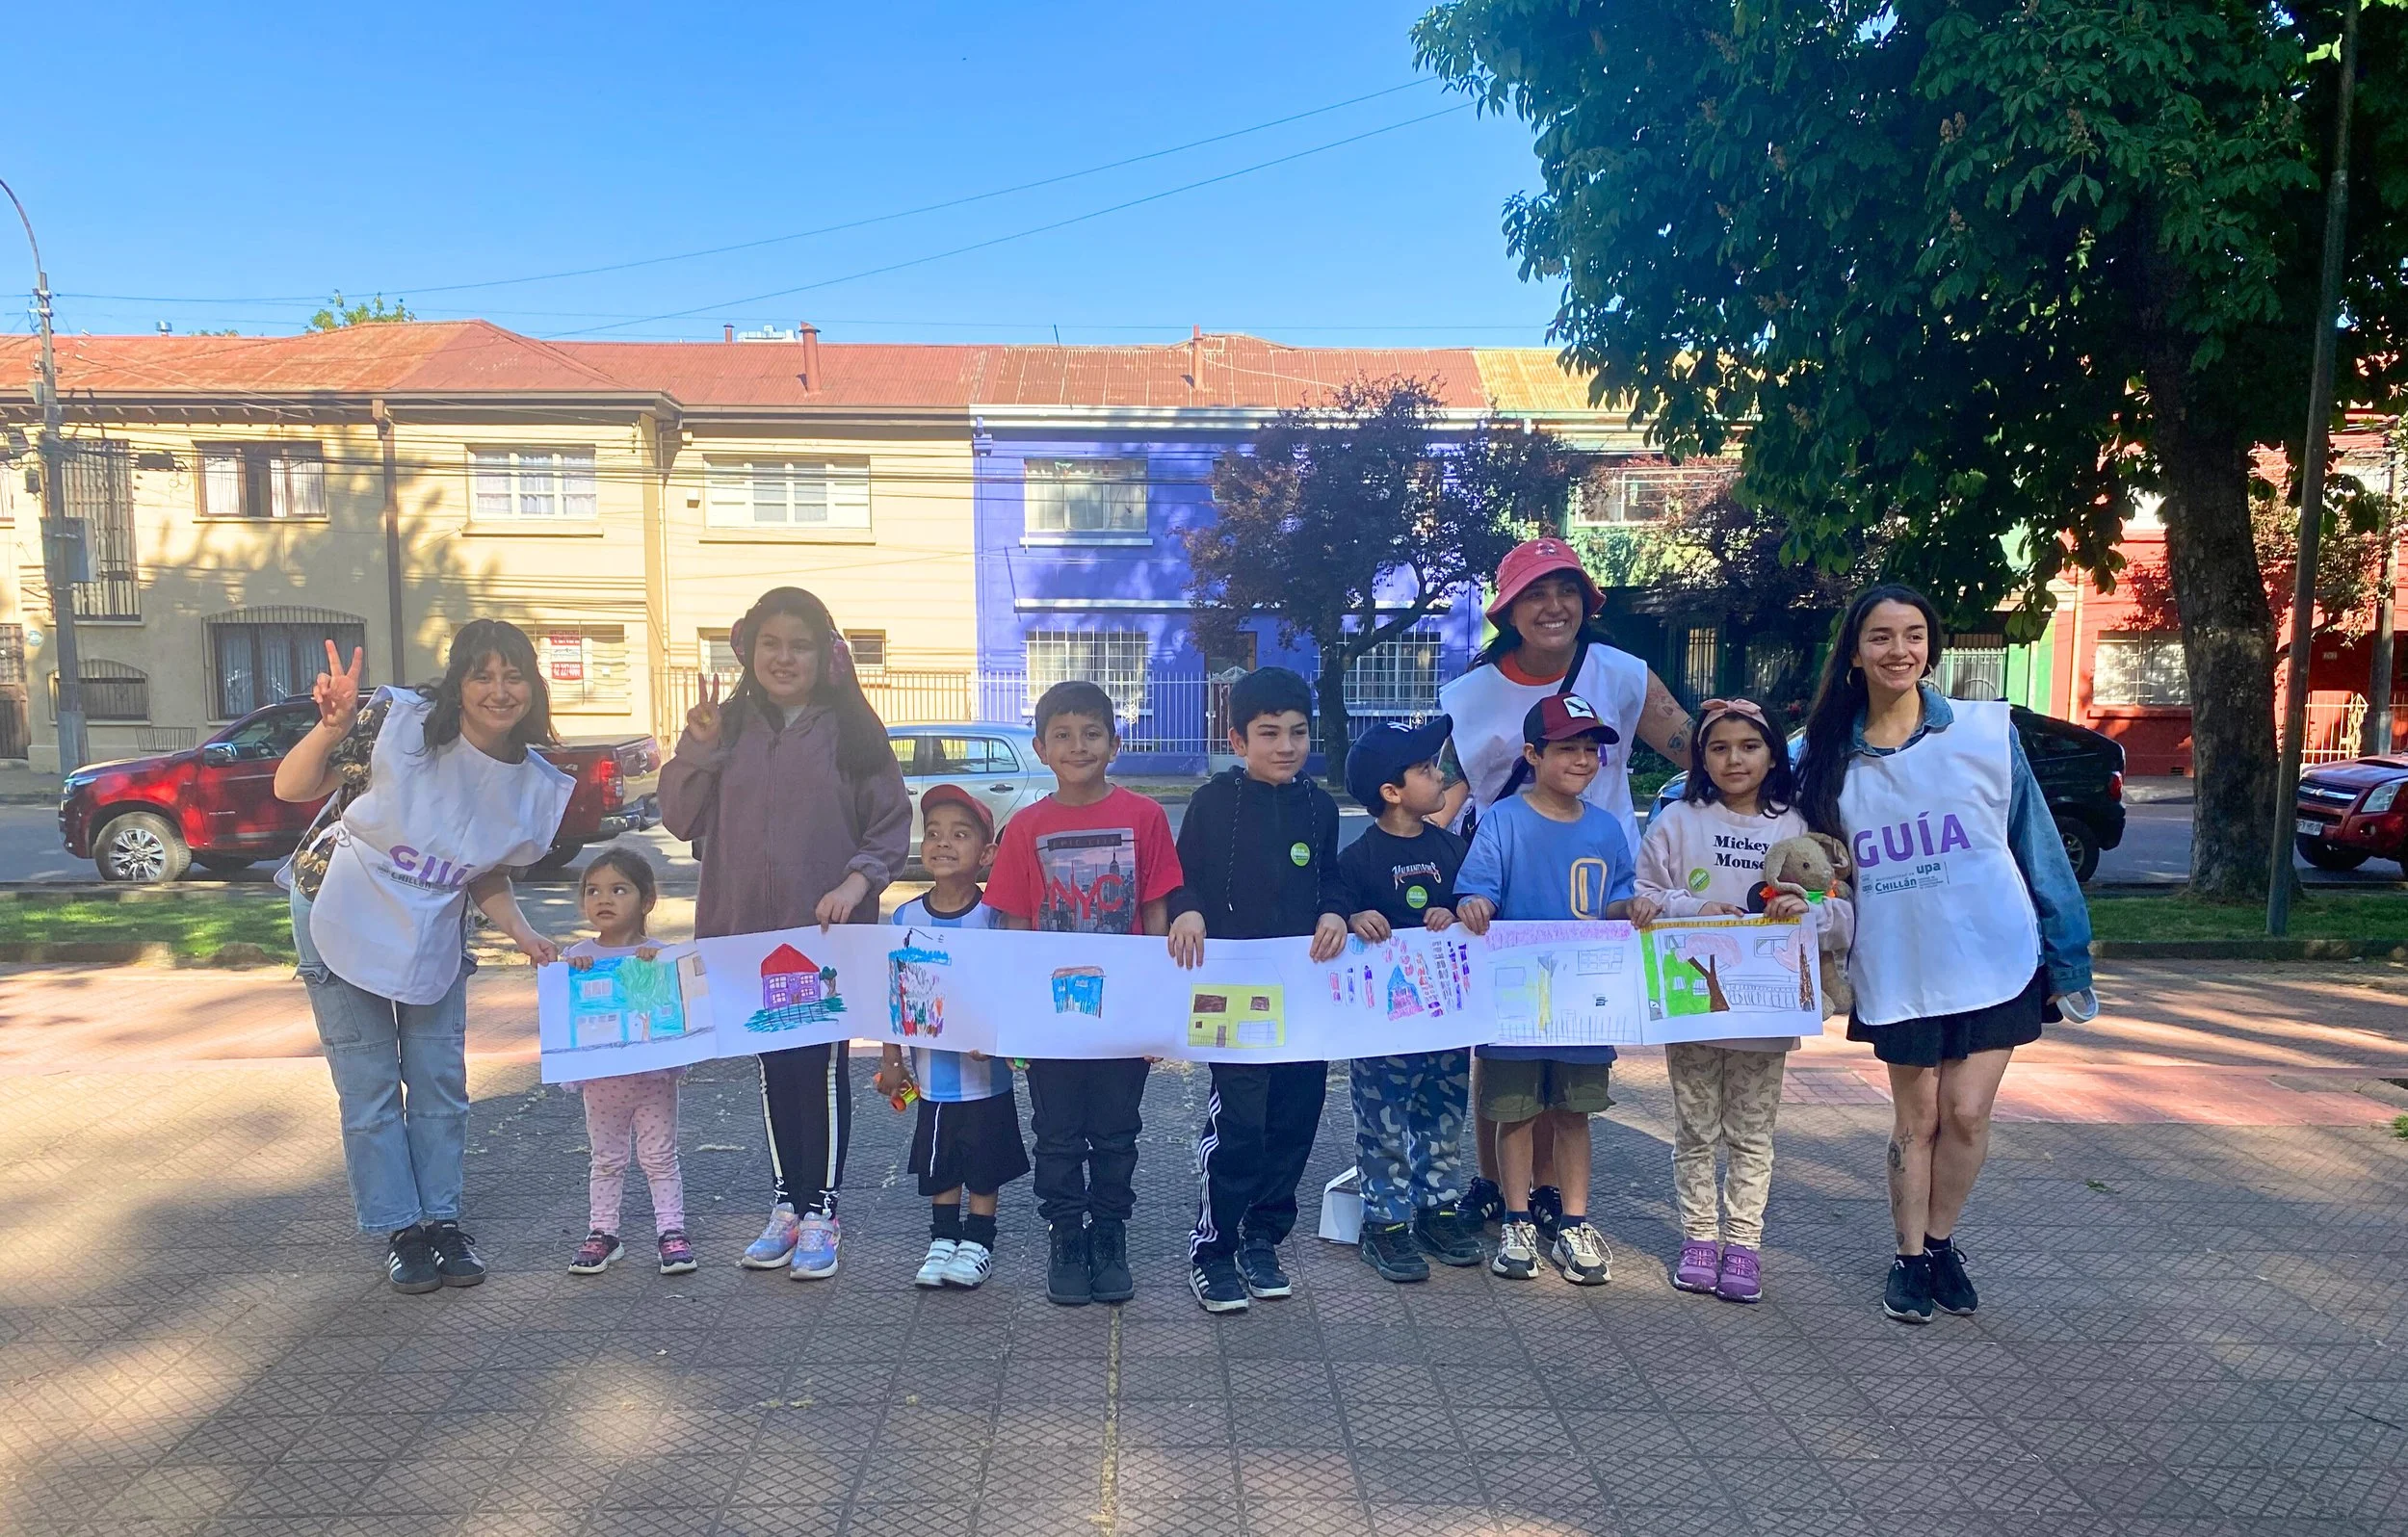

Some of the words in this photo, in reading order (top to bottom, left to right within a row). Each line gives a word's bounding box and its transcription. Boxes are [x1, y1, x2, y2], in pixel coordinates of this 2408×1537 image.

[1713, 835, 1770, 855] Mickey
[1853, 811, 1972, 868] GUÍA
[1714, 852, 1766, 871] Mouse
[1916, 862, 1941, 875] upa
[1049, 874, 1123, 920] NYC
